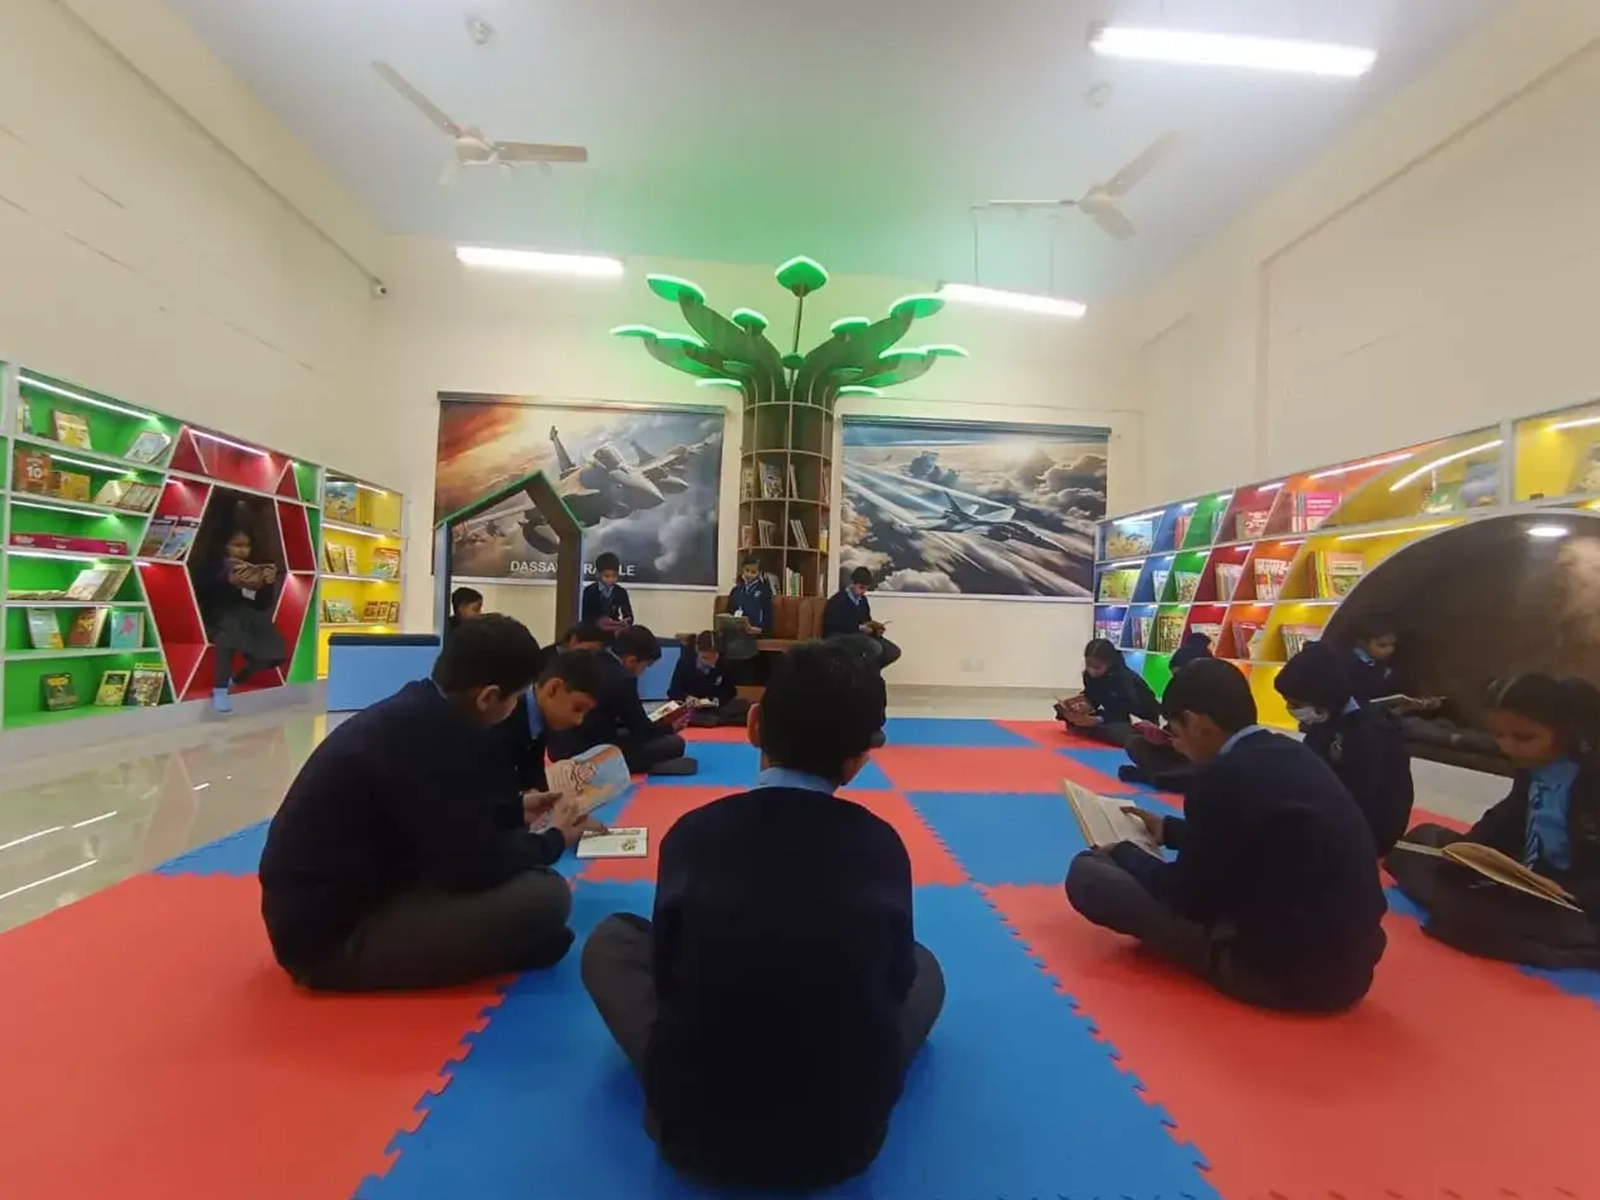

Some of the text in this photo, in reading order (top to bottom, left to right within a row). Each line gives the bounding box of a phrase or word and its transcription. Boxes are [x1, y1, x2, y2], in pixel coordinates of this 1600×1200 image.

[26, 465, 43, 479] 10
[510, 560, 636, 576] DASSA RLE
